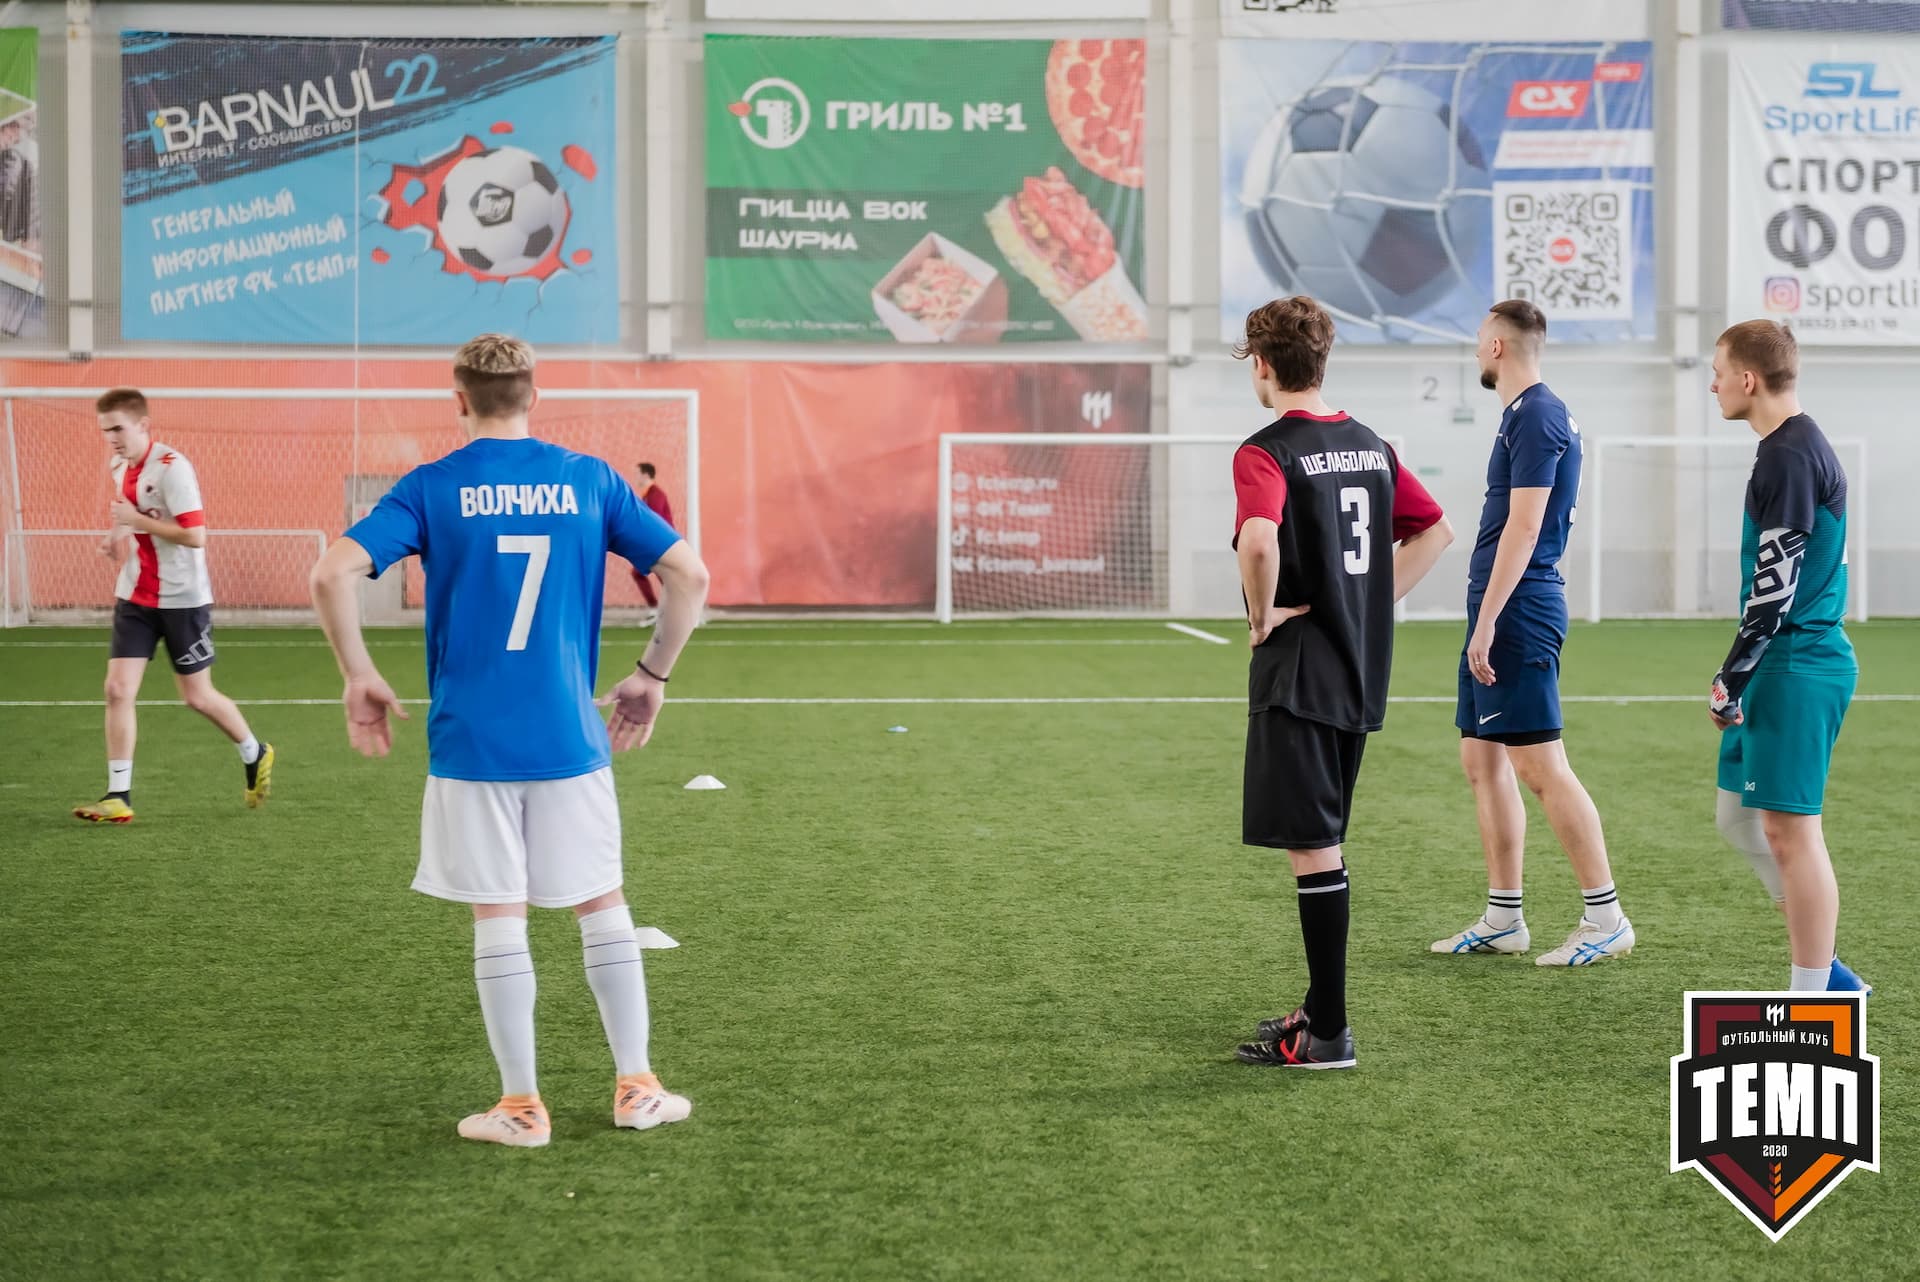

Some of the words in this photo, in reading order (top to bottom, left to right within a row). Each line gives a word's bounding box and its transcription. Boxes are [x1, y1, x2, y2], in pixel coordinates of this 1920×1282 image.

[1803, 63, 1901, 98] SL
[826, 101, 953, 130] ГРИЛЬ
[963, 102, 1027, 131] №1
[151, 187, 295, 240] ГЕНЕРАЛЬНЫЙ
[739, 198, 850, 221] ПИЦЦА
[863, 201, 927, 220] ВОК
[152, 213, 347, 280] ИНФОРМАЦИОННЫЙ
[739, 229, 858, 250] ШАУРМА
[1766, 203, 1920, 270] ФО
[150, 275, 238, 315] ПАРТНЕР
[243, 267, 277, 295] ФК
[283, 253, 358, 287] «ТЕМП»
[1422, 376, 1439, 400] 2
[460, 484, 579, 517] ВОЛЧИХА
[1340, 486, 1371, 575] 3
[497, 535, 551, 651] 7
